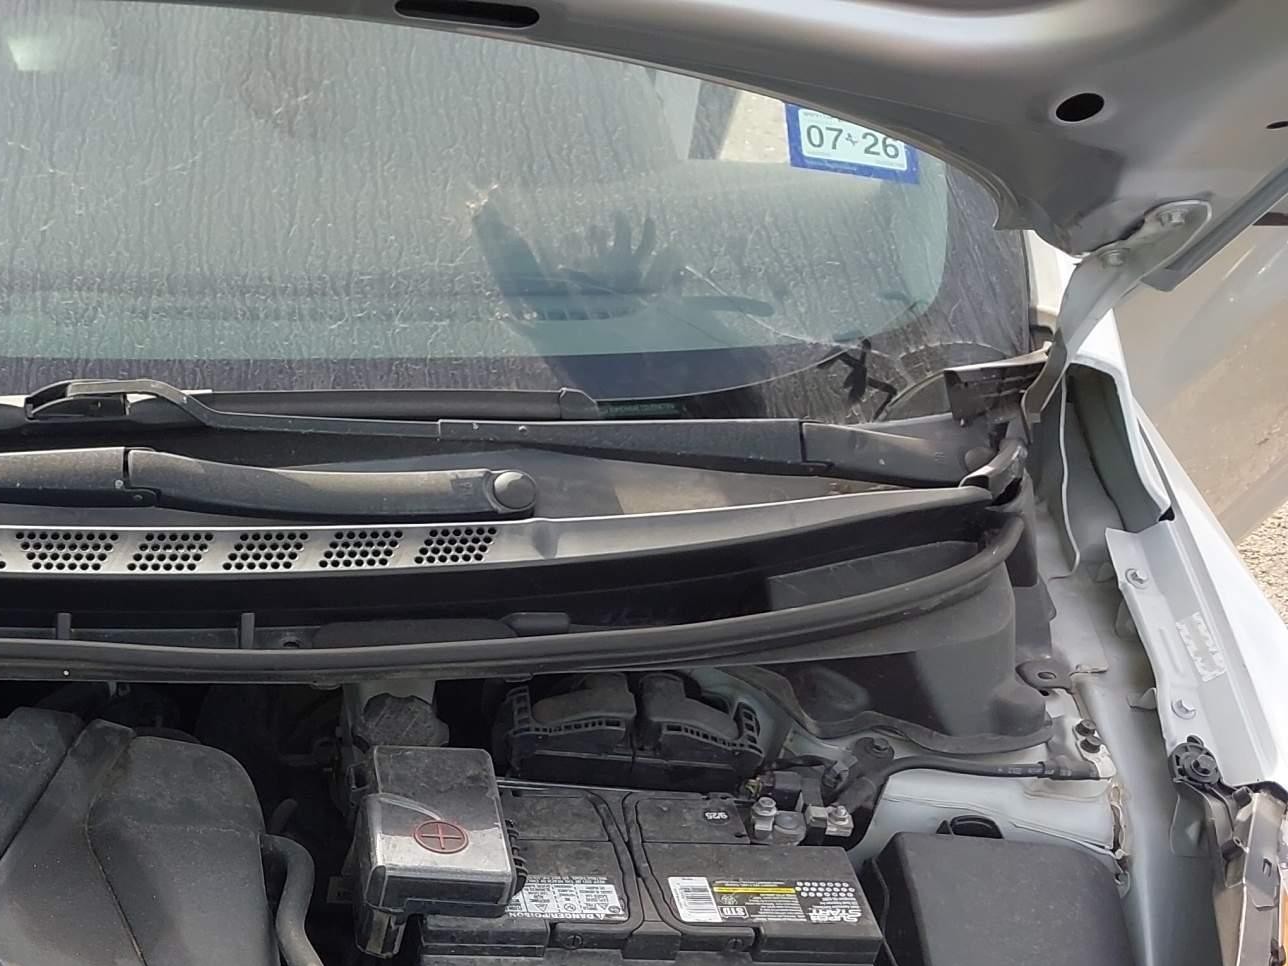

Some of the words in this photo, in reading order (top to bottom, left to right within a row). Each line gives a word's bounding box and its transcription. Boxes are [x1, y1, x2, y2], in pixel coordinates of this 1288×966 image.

[806, 124, 843, 150] 07
[861, 131, 901, 159] 26
[808, 908, 862, 918] START
